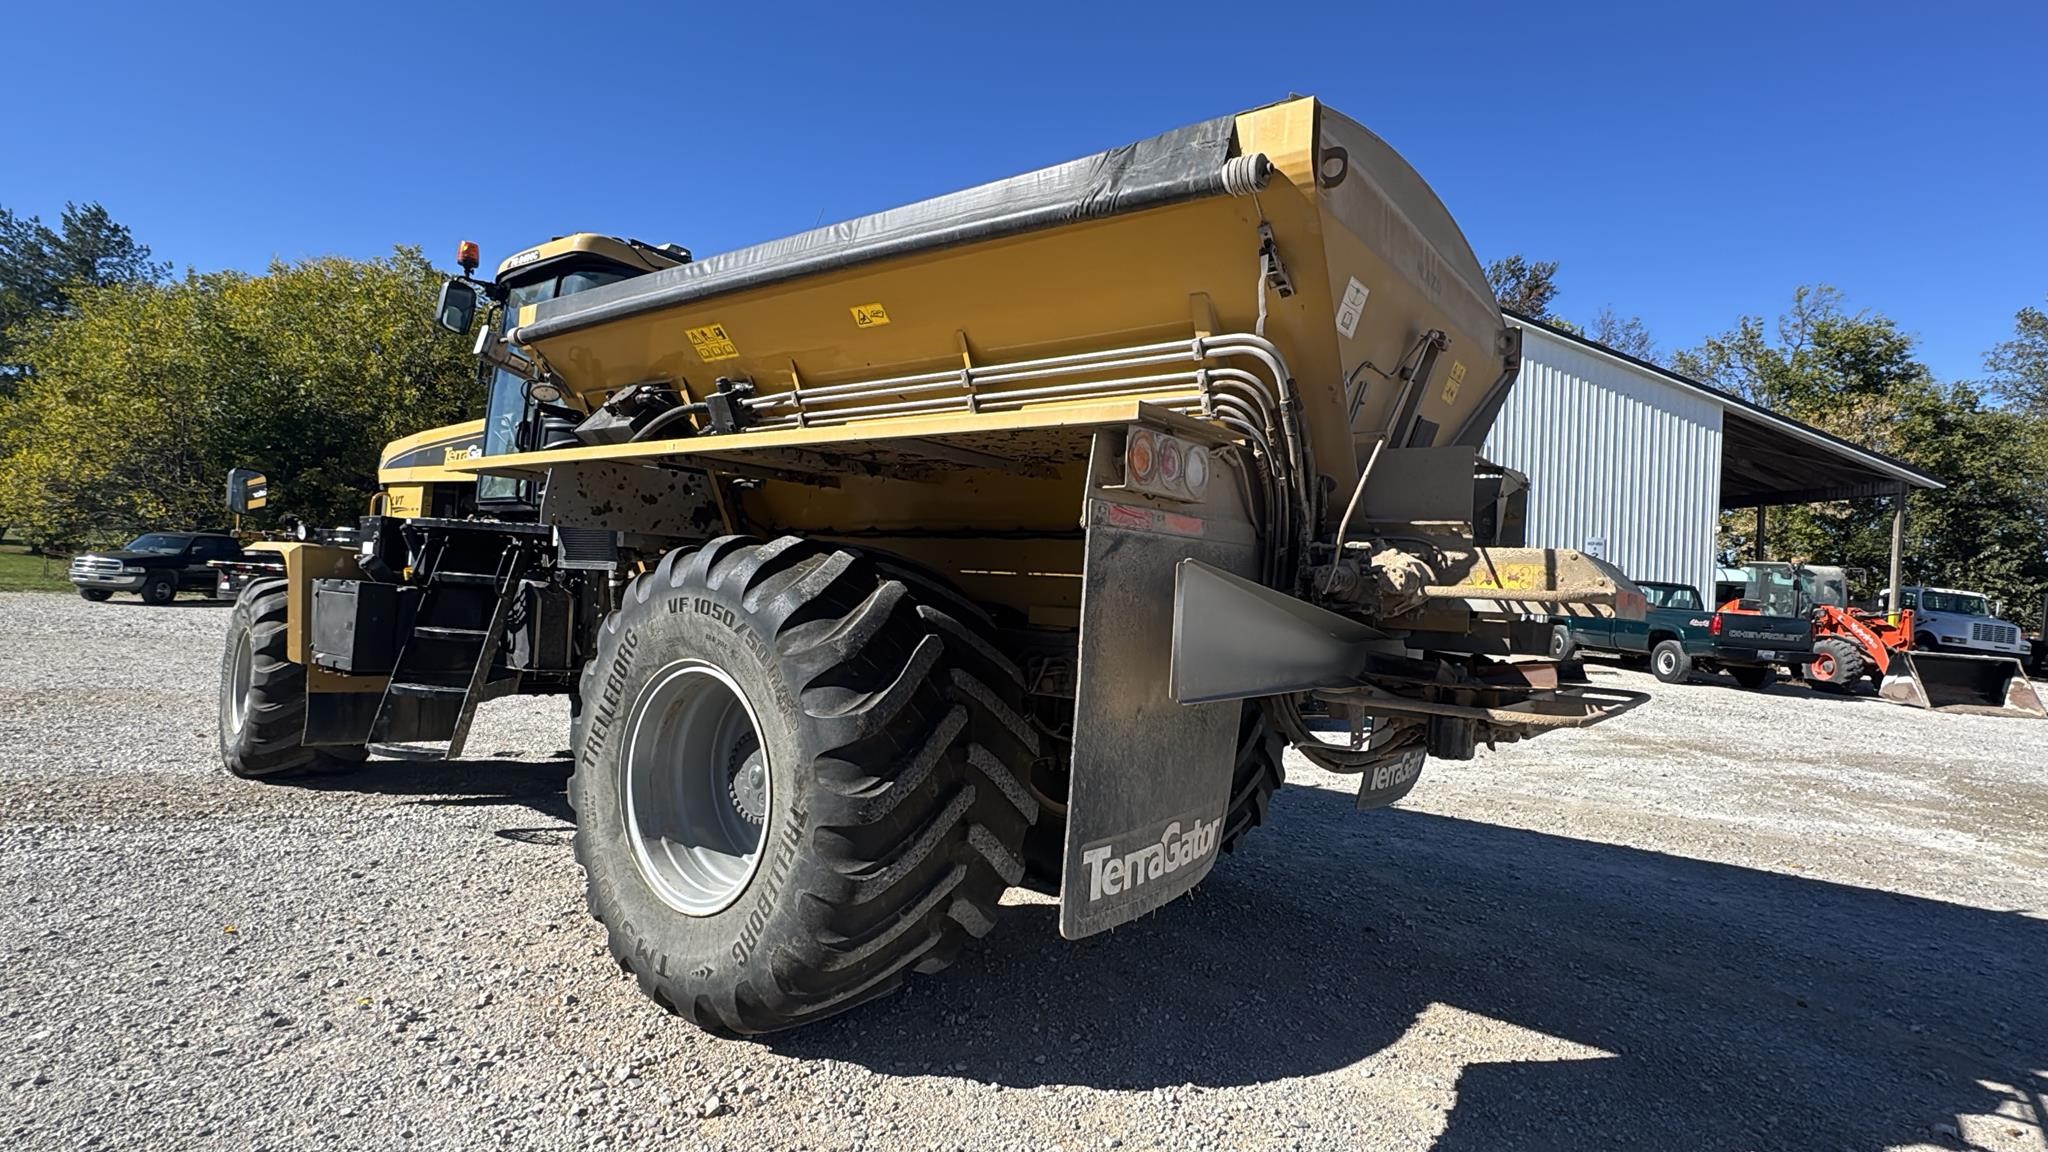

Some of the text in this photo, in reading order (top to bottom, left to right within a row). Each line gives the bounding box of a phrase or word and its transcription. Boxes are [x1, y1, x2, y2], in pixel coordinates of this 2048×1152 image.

[668, 597, 689, 614] VF
[1728, 629, 1803, 642] CHEVROLET
[581, 627, 639, 769] TRELLEBORG
[731, 804, 809, 968] TRELLEBORG
[1082, 817, 1222, 903] TerraGator
